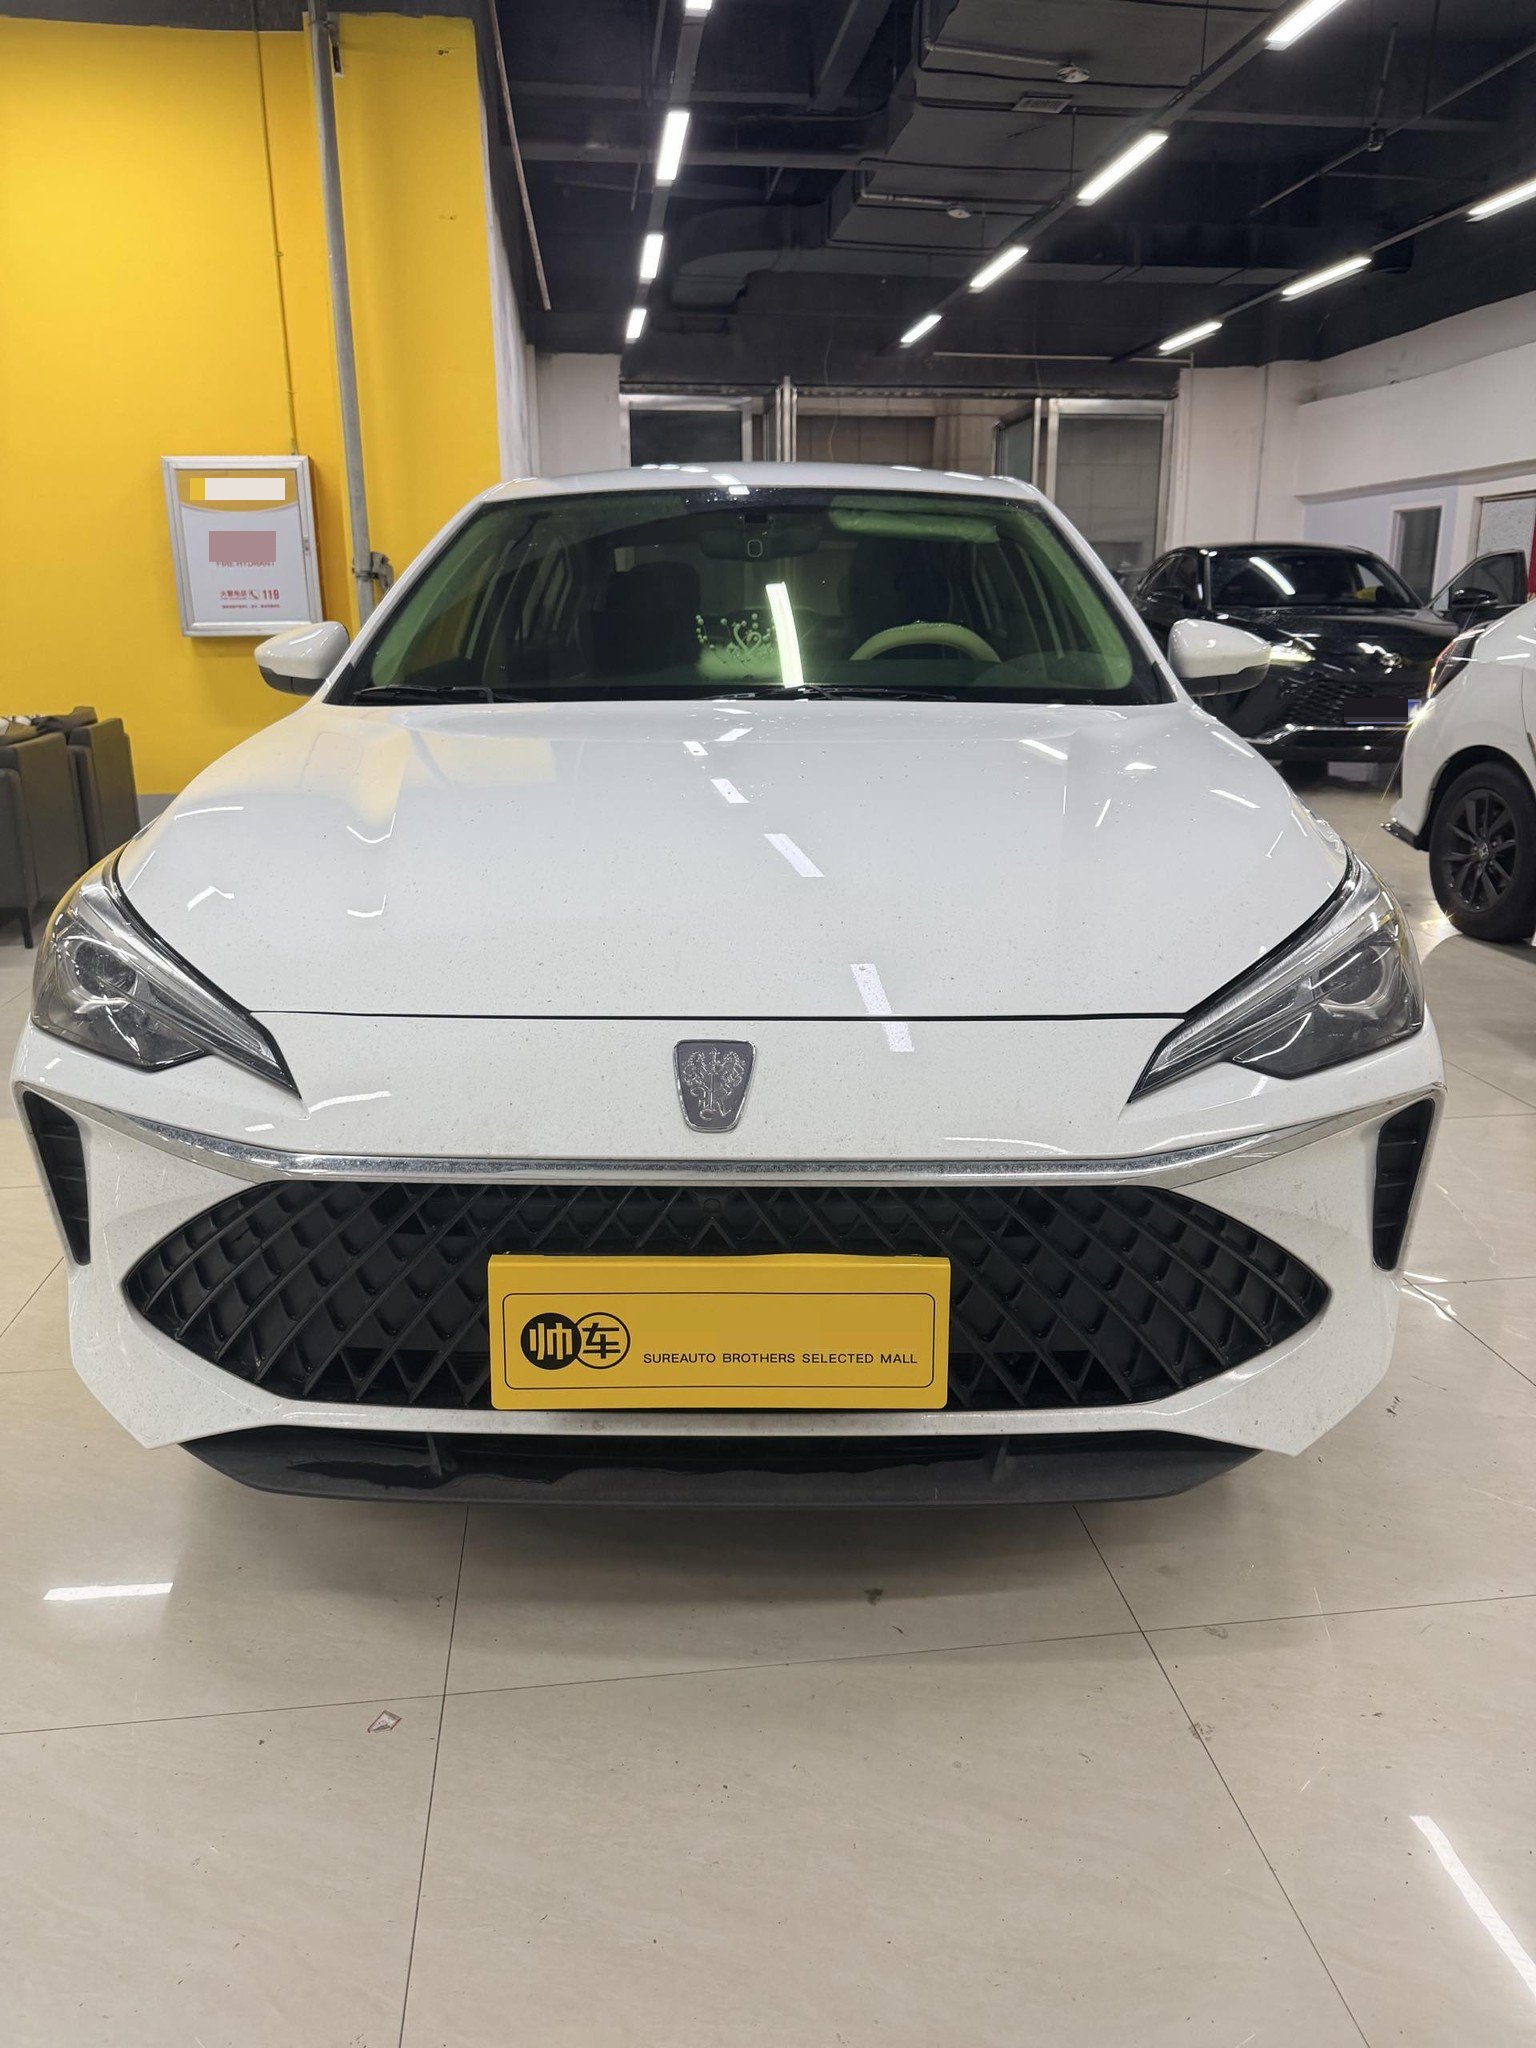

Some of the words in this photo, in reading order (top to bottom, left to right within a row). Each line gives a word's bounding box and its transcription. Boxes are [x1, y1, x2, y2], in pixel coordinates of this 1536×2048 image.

[262, 589, 280, 600] 119
[528, 1321, 622, 1361] 帅车
[643, 1353, 716, 1364] SUREAUTO
[722, 1353, 796, 1364] BROTHERS
[802, 1353, 874, 1364] SELECTED
[880, 1353, 918, 1364] MALL
